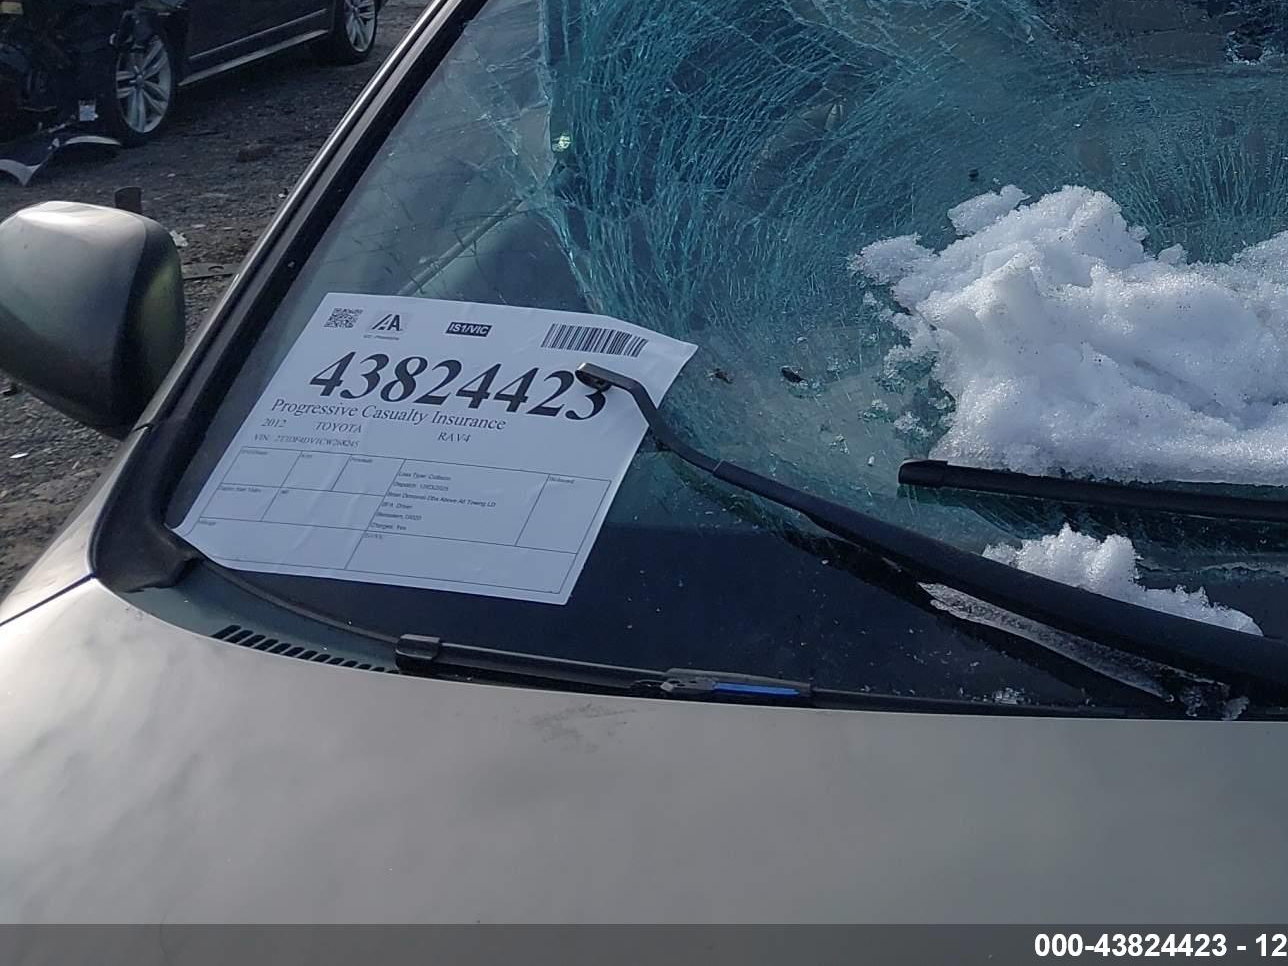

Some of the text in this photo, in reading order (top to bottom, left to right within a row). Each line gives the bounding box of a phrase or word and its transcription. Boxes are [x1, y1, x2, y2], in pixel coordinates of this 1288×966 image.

[308, 351, 607, 421] 43824423
[271, 398, 507, 430] Progressive Casualty Insurance
[261, 418, 472, 444] 2012 TOYOTA RAV4
